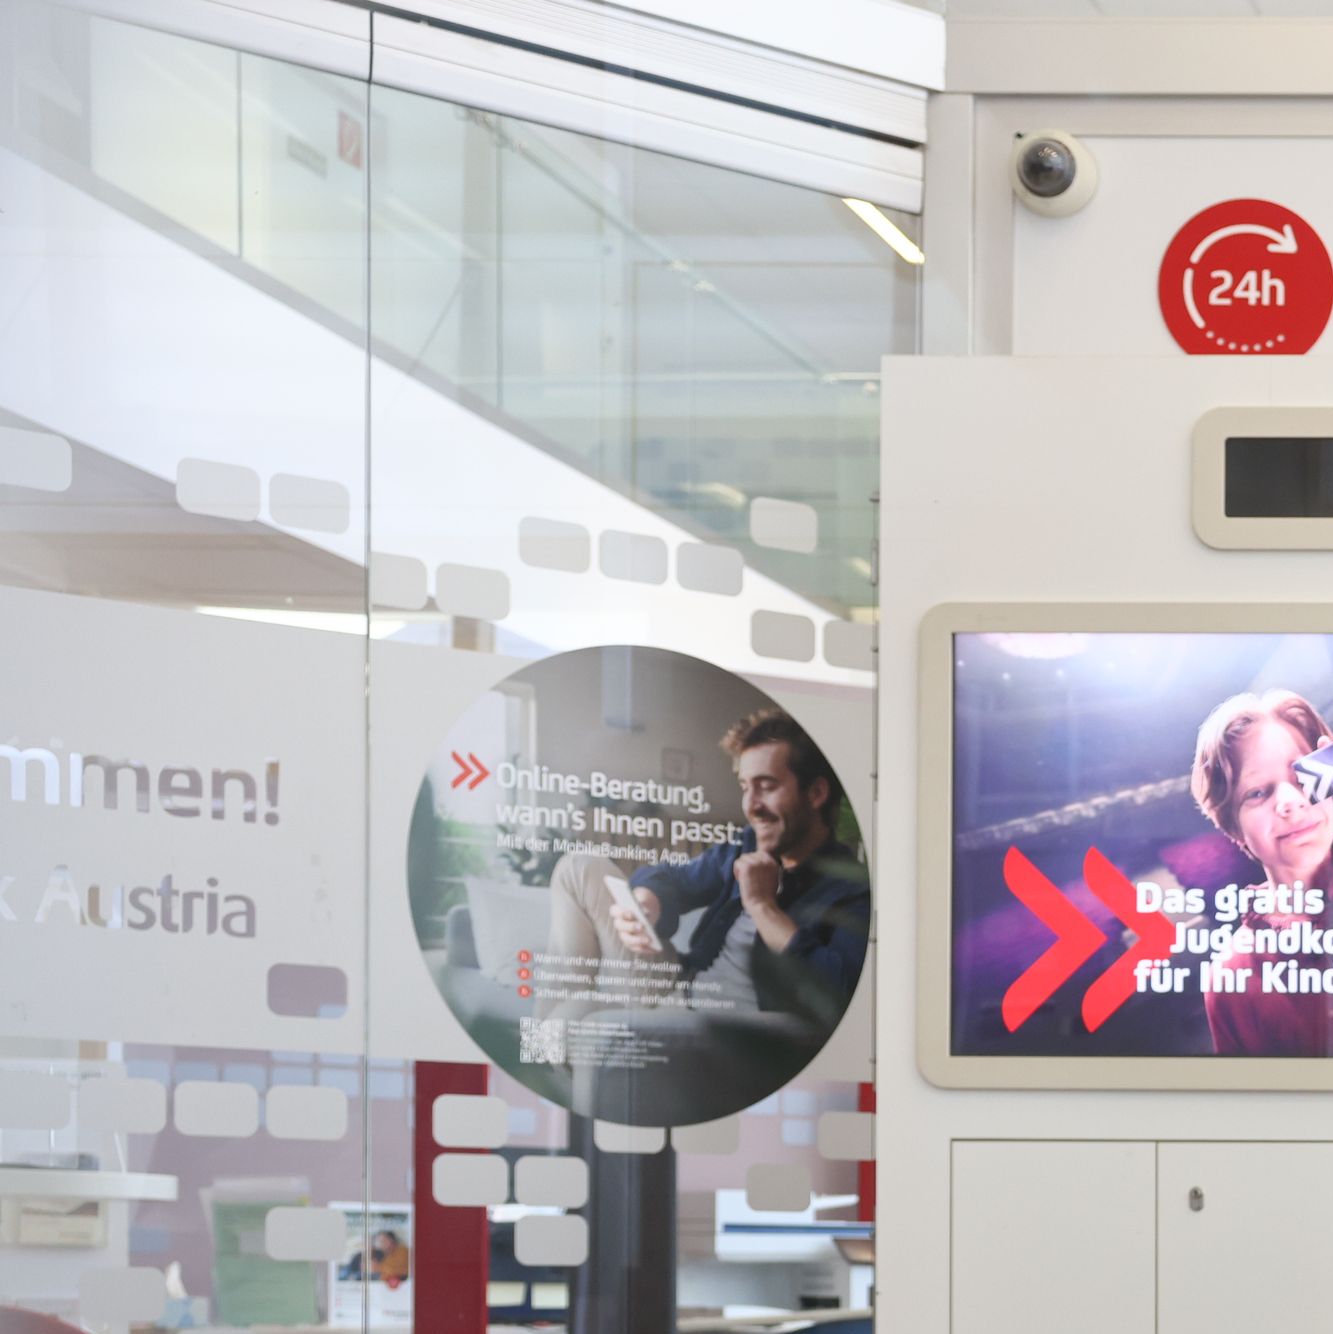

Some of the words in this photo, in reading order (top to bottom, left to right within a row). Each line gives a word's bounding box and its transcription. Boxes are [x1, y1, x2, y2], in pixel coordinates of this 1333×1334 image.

[1208, 270, 1286, 306] 24h
[497, 762, 711, 813] Online-Beratung,
[593, 807, 663, 838] Ihnen
[497, 833, 522, 849] Mit
[525, 836, 550, 851] der
[553, 838, 656, 865] MobileBanking
[34, 864, 256, 938] Austria
[1136, 881, 1205, 914] Das
[1214, 880, 1325, 922] gratis
[1133, 959, 1190, 993] für
[1200, 960, 1252, 993] Ihr
